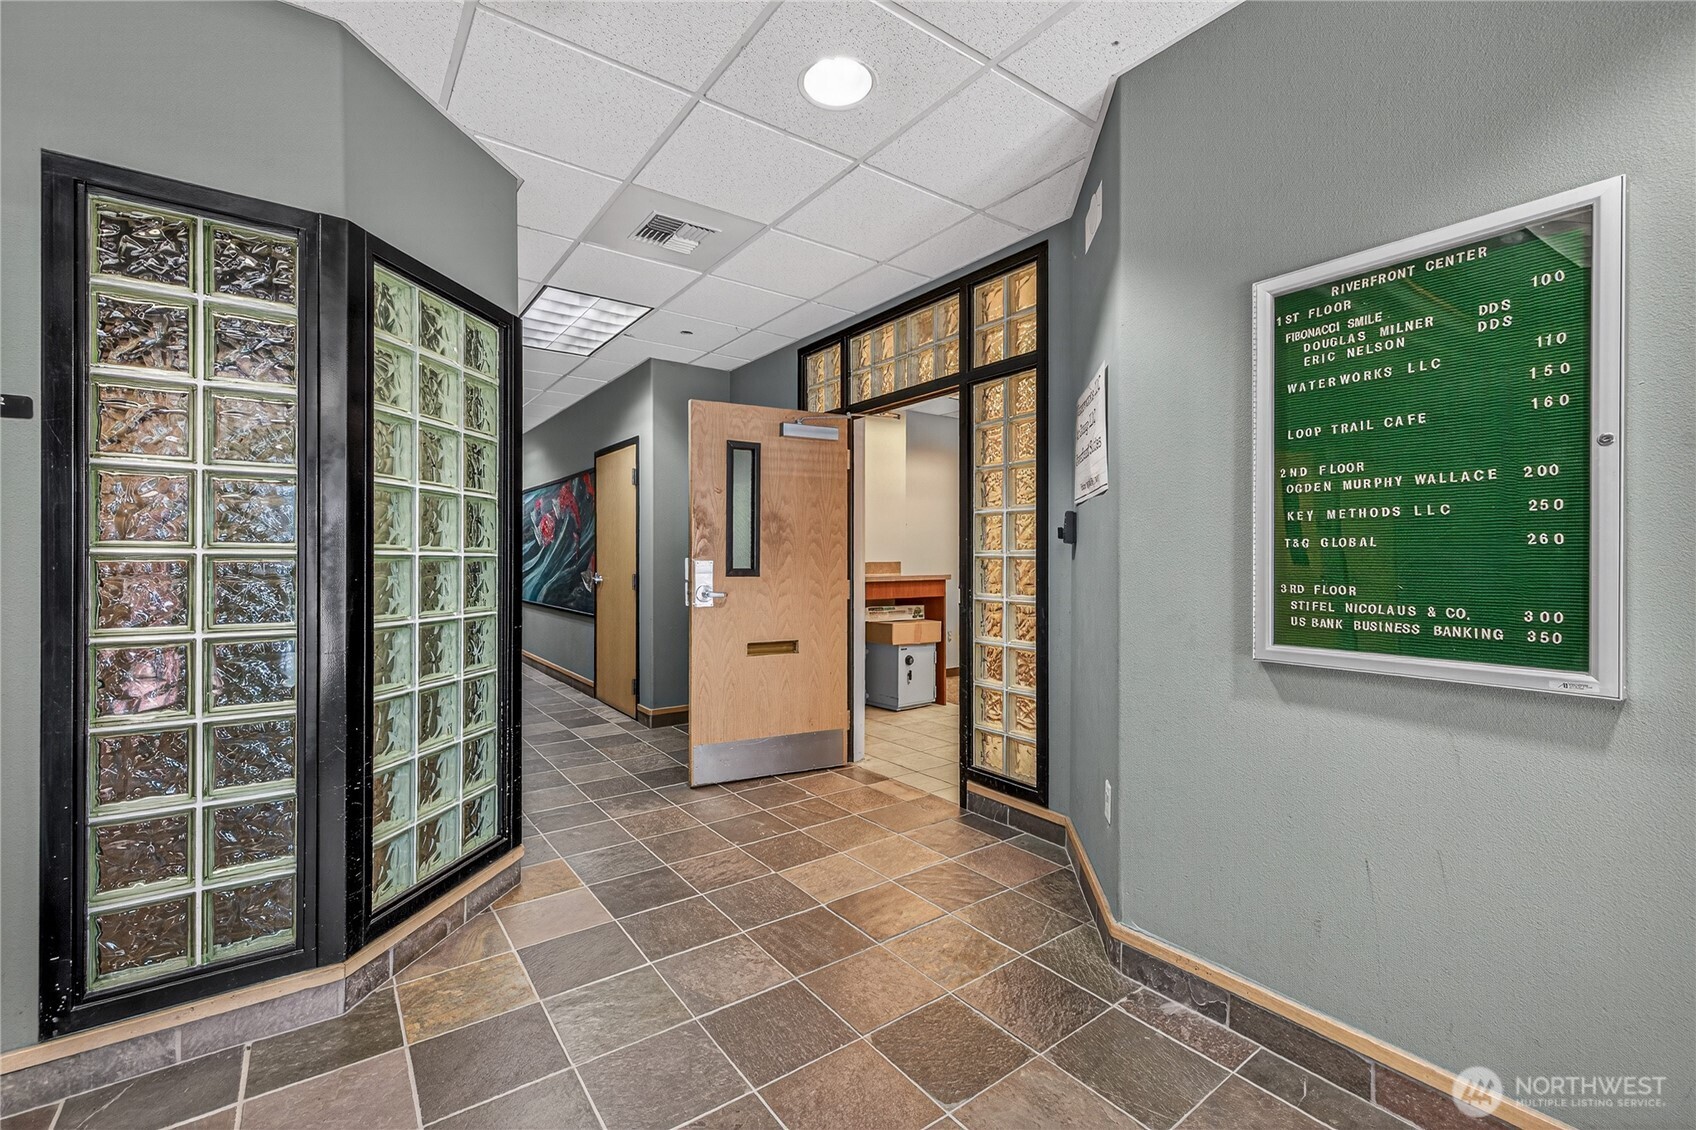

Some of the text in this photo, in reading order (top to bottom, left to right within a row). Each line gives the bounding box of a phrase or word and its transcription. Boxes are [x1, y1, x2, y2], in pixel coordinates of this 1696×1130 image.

[1331, 246, 1488, 297] RIVERFRONT CENTER
[1531, 270, 1565, 287] 100
[1277, 300, 1351, 326] 1ST FLOOR
[1479, 299, 1510, 315] DDS
[1286, 312, 1382, 344] FIBONACCI SMILE
[1303, 316, 1434, 353] DOUGLAS MILNER
[1478, 316, 1512, 332] DDS
[1304, 335, 1404, 366] ERIC NELSON
[1535, 333, 1566, 347] 110
[1288, 359, 1440, 393] WATERWORKS LLC
[1530, 363, 1570, 378] 150
[1532, 394, 1569, 409] 160
[1288, 413, 1426, 439] LOOP TRAIL CAFE
[1281, 462, 1364, 477] 2ND FLOOR
[1287, 464, 1558, 493] OGDEN MURPHY WALLACE 200
[1288, 499, 1563, 521] KEY METHODS LLC 250
[1285, 533, 1564, 548] T&G GLOBAL 260
[1281, 584, 1356, 595] 3RD FLOOR
[1291, 601, 1563, 623] STIFEL NICOLAUS & CO. 300
[1291, 617, 1562, 644] US BANK BUSINESS BANKING 350
